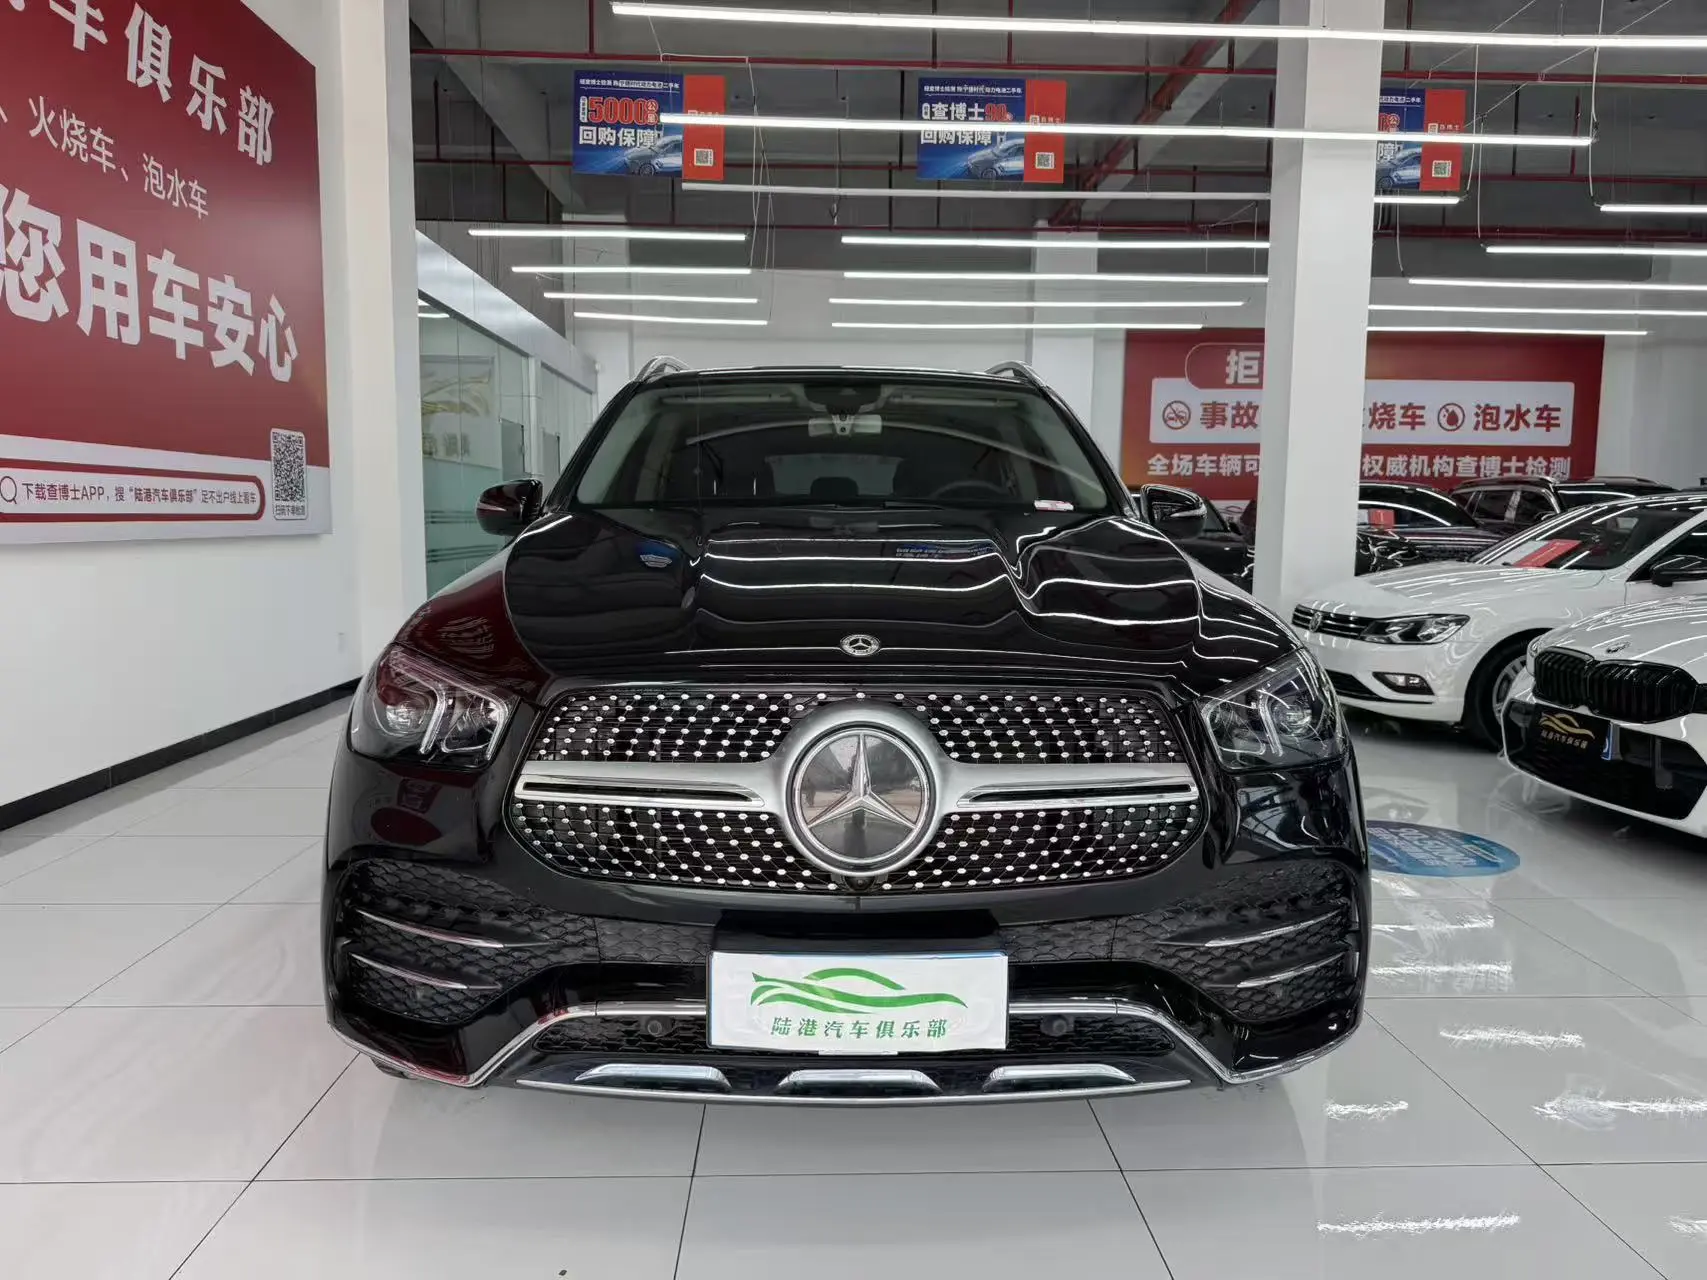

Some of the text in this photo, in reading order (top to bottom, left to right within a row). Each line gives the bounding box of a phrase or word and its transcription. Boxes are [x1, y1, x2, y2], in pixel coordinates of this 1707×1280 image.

[579, 126, 656, 148] 回购保障
[0, 183, 299, 383] 您用车安心
[1225, 349, 1261, 385] 拒
[1199, 401, 1260, 430] 事故
[1473, 403, 1562, 432] 泡水车
[1362, 454, 1572, 482] 权威机构查博士检测
[769, 1017, 948, 1039] 陆港汽车俱乐部
